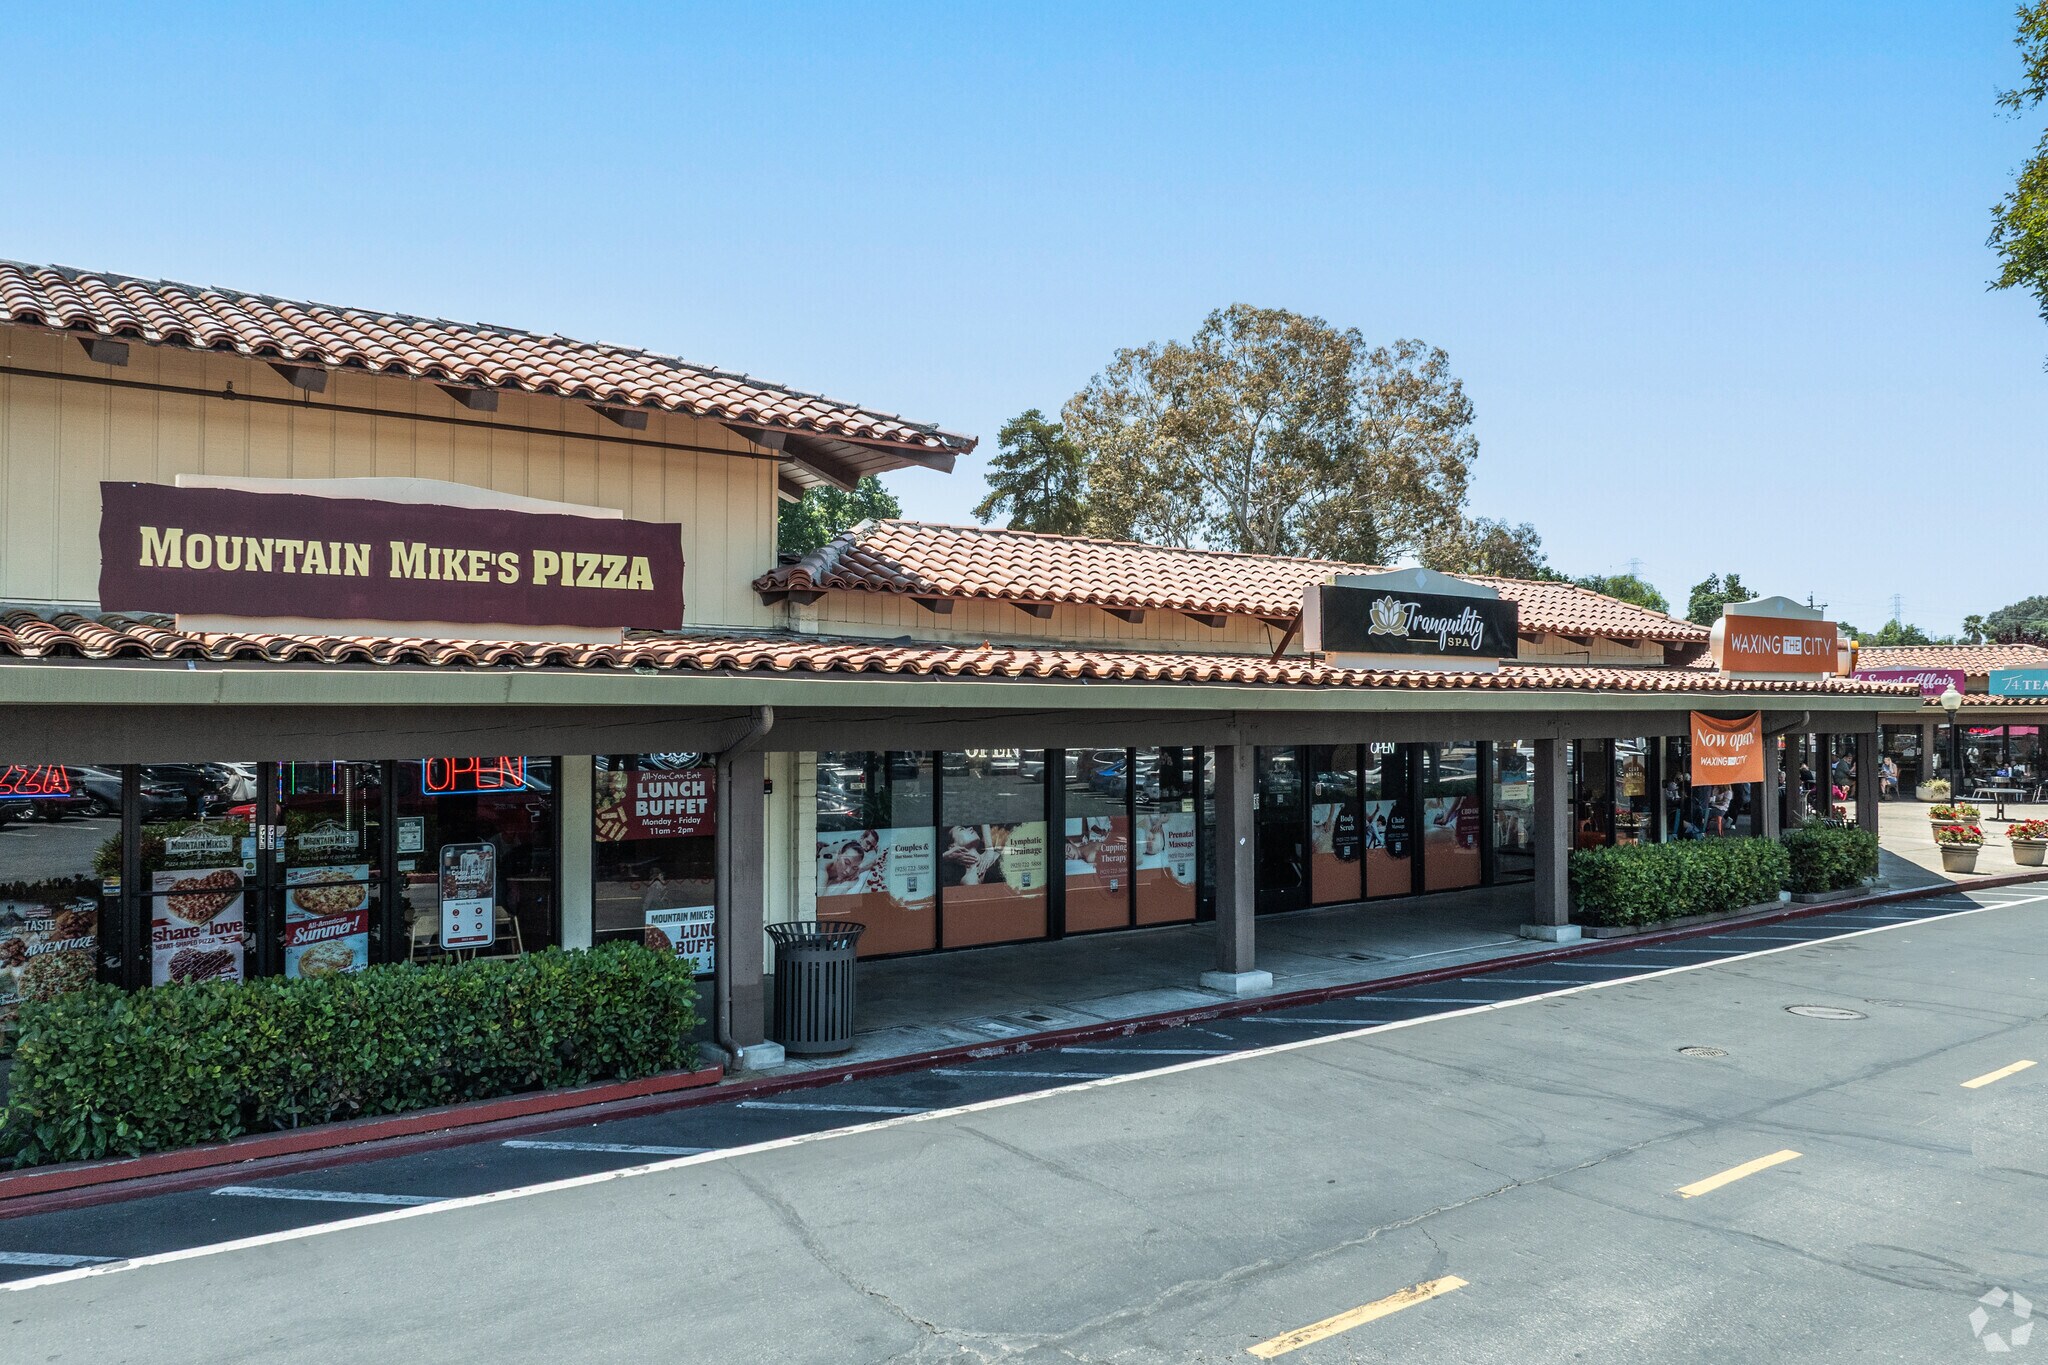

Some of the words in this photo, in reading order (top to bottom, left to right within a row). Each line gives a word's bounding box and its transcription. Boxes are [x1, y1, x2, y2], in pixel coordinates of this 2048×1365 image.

[139, 526, 371, 577] MOUNTAIN
[390, 541, 520, 585] MIKE'S
[532, 549, 655, 591] PIZZA
[1401, 602, 1484, 651] Tranquility
[1447, 637, 1470, 647] SPA
[1731, 633, 1781, 655] WAXING
[1784, 638, 1801, 652] THE
[1803, 636, 1832, 656] CITY
[1906, 672, 1956, 689] Affair
[1695, 728, 1729, 747] Now
[1370, 742, 1395, 754] OPEN
[1700, 756, 1728, 766] WAXING
[427, 756, 523, 791] OPEN
[641, 771, 702, 781] All-You-Can-Eat
[636, 780, 706, 799] LUNCH
[635, 798, 708, 817] BUFFET
[642, 818, 672, 826] Monday
[678, 816, 701, 825] Friday
[650, 827, 671, 835] 11am
[677, 826, 694, 835] 2pm
[1168, 829, 1194, 838] Prenatal
[171, 840, 206, 851] MOUNTAIN
[303, 836, 335, 846] MOUNTAIN
[1010, 836, 1042, 847] Lymphatic
[1168, 841, 1194, 849] Massage
[895, 843, 922, 854] Couples
[923, 843, 929, 851] &
[1010, 847, 1042, 856] Drainage
[1100, 842, 1128, 854] Cupping
[1101, 854, 1127, 863] Therapy
[307, 916, 348, 929] All-American
[651, 912, 689, 924] MOUNTAIN
[690, 910, 714, 921] MIKE'S
[24, 919, 57, 932] TASTE
[152, 926, 201, 943] share
[209, 920, 243, 936] love
[292, 915, 360, 945] Summer!
[24, 935, 96, 958] ADVENTURE
[156, 940, 198, 951] HEART-SHAPED
[198, 937, 216, 945] PIZZA
